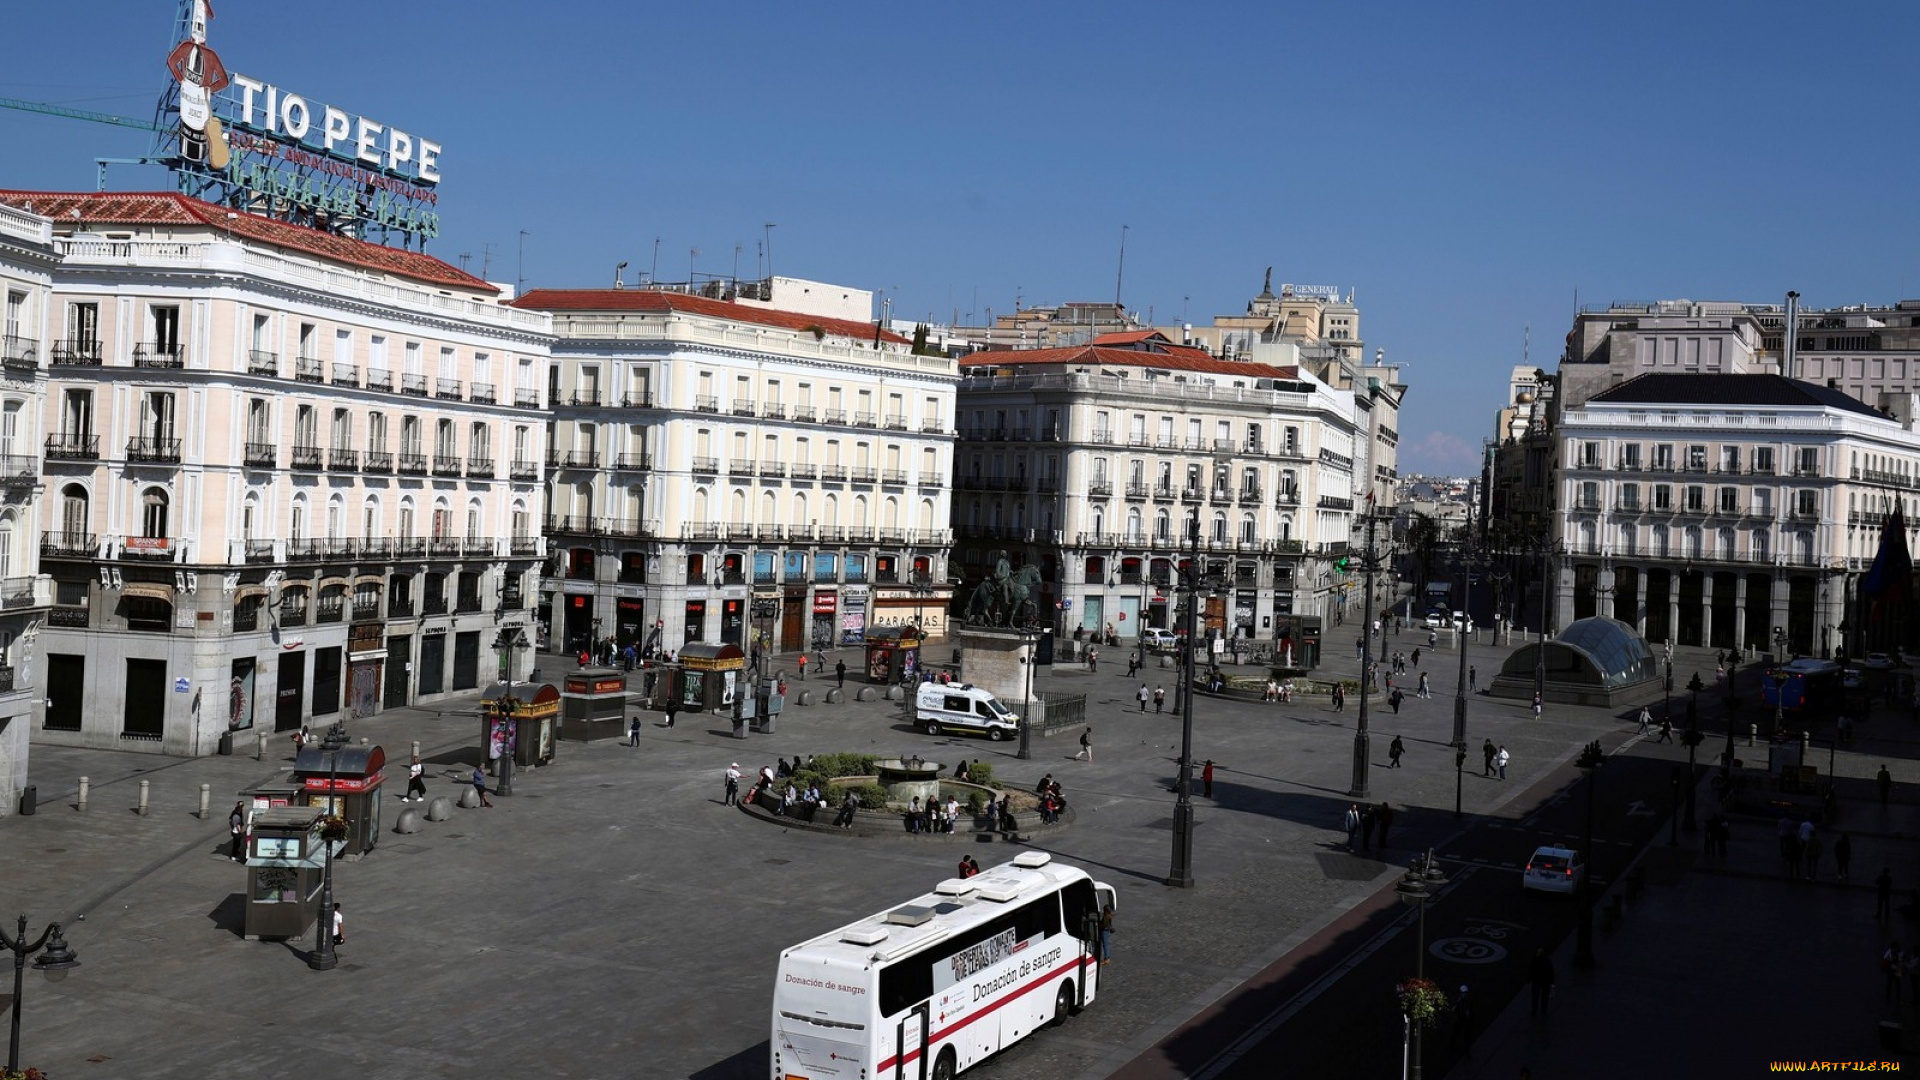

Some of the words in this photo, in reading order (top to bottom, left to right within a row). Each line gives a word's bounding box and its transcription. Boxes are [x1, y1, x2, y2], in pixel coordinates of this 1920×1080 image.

[234, 72, 310, 139] TIO
[324, 104, 441, 184] PEPE
[1295, 284, 1338, 294] GENERALI
[619, 601, 641, 610] Orange
[425, 626, 446, 634] SEPHORA
[1445, 942, 1489, 958] 30
[972, 967, 1017, 1002] Donación
[1019, 960, 1031, 978] de
[1032, 946, 1062, 970] sangre
[785, 973, 823, 988] Donación
[825, 980, 835, 990] de
[837, 983, 866, 995] sangre
